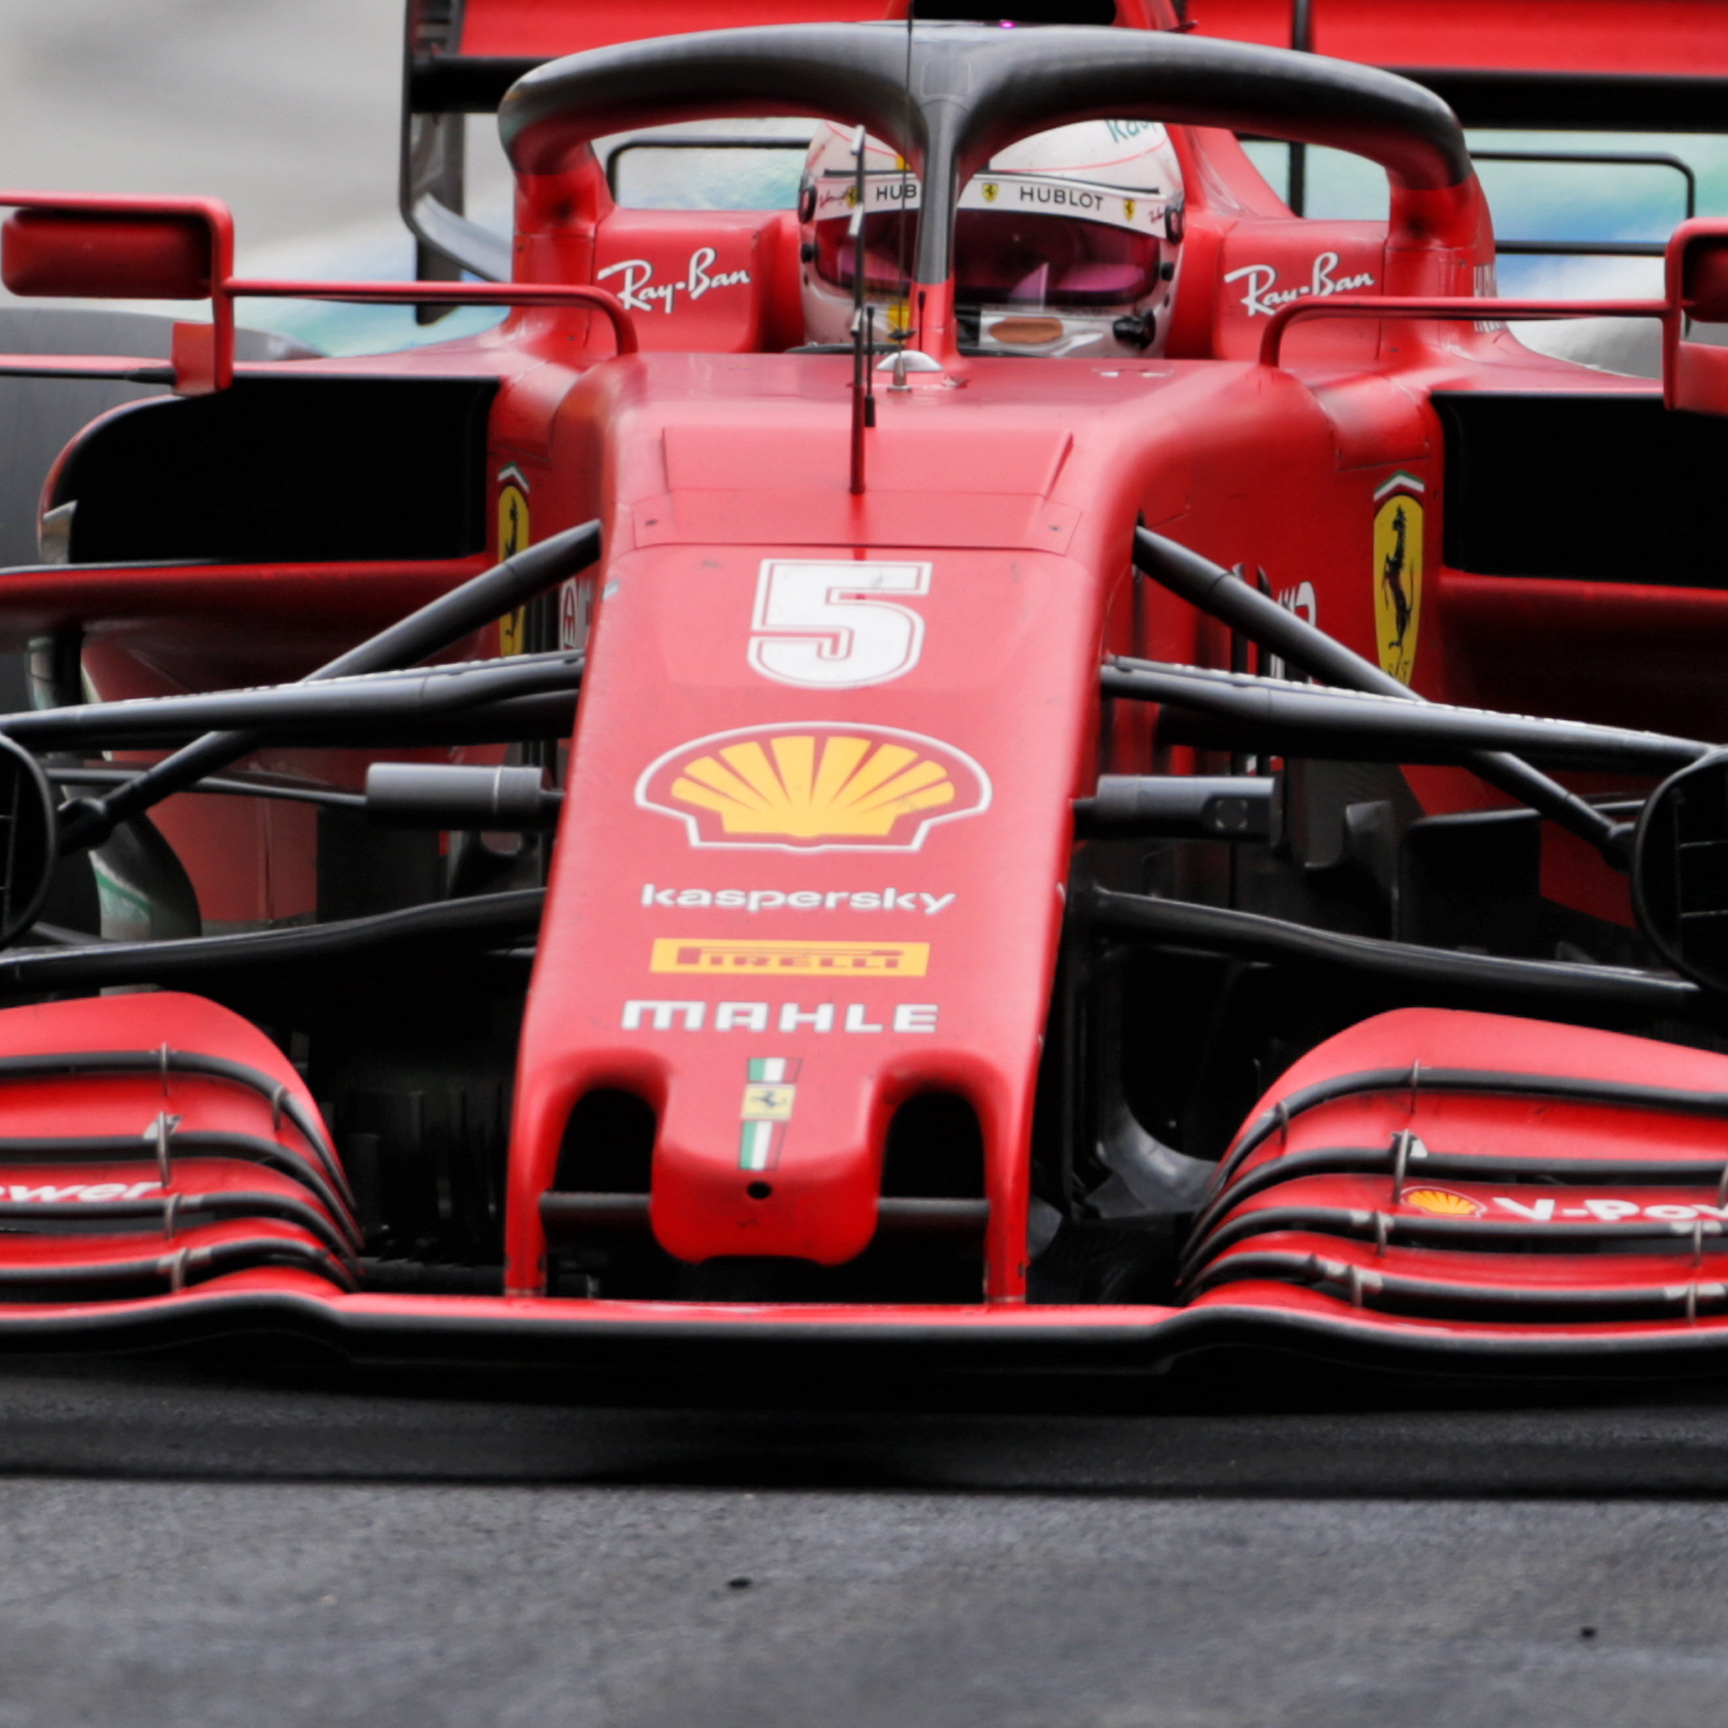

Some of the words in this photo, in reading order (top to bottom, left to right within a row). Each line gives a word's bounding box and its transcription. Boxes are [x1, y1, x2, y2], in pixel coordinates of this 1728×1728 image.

[1019, 186, 1104, 211] HUBLOT
[597, 247, 752, 314] Ray-Ban
[746, 558, 933, 690] 5
[641, 883, 957, 915] kaspersky
[676, 946, 904, 968] PIRELLI
[621, 1000, 939, 1033] MAHLE
